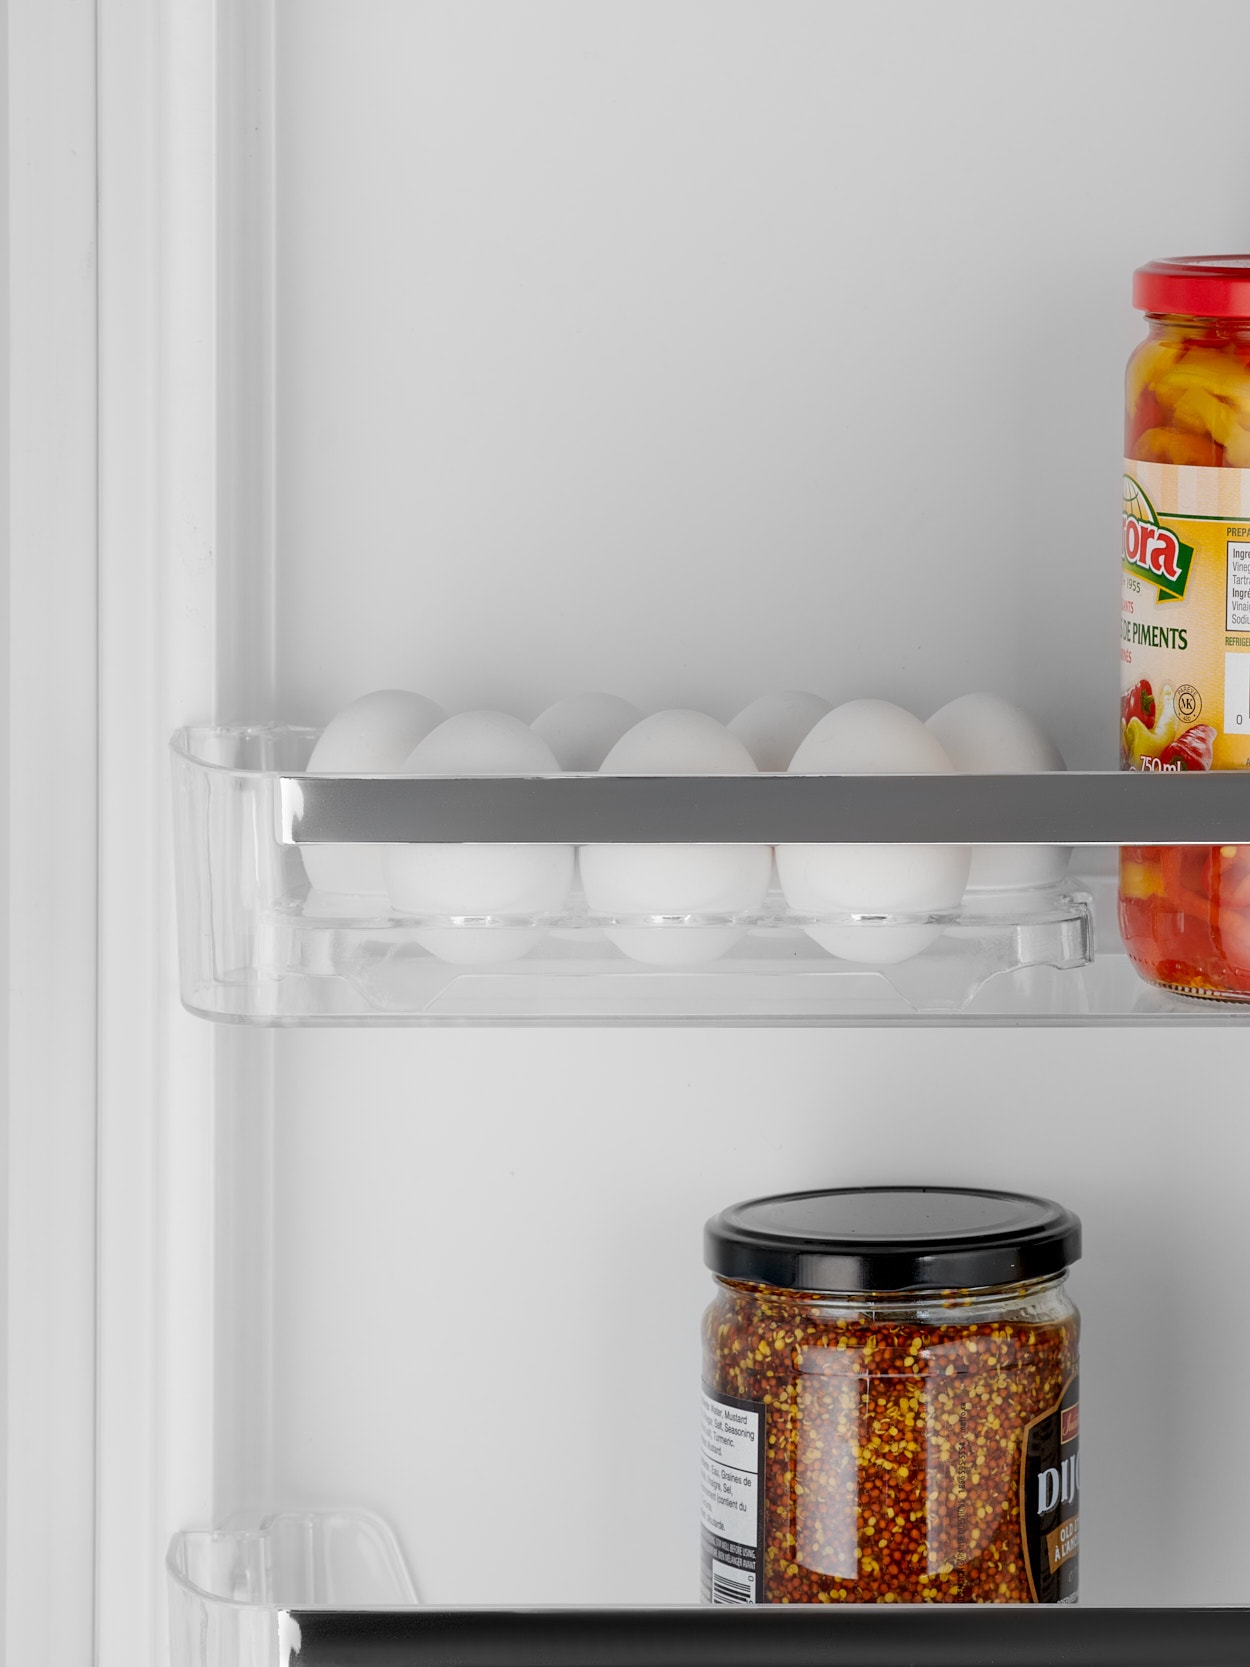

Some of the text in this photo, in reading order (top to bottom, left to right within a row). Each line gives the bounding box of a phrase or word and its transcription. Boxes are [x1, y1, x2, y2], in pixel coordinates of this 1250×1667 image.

[1123, 517, 1179, 579] ora
[1132, 622, 1188, 651] PIMENTS
[1236, 714, 1243, 725] 0
[1140, 755, 1162, 772] 750
[724, 1409, 748, 1425] Mustard
[724, 1422, 755, 1442] Seasoning
[721, 1469, 752, 1487] Graines de
[739, 1502, 747, 1512] du
[1060, 1524, 1073, 1543] OLD
[730, 1543, 743, 1556] BEFORE
[1054, 1545, 1061, 1563] À
[743, 1559, 756, 1571] AVANT
